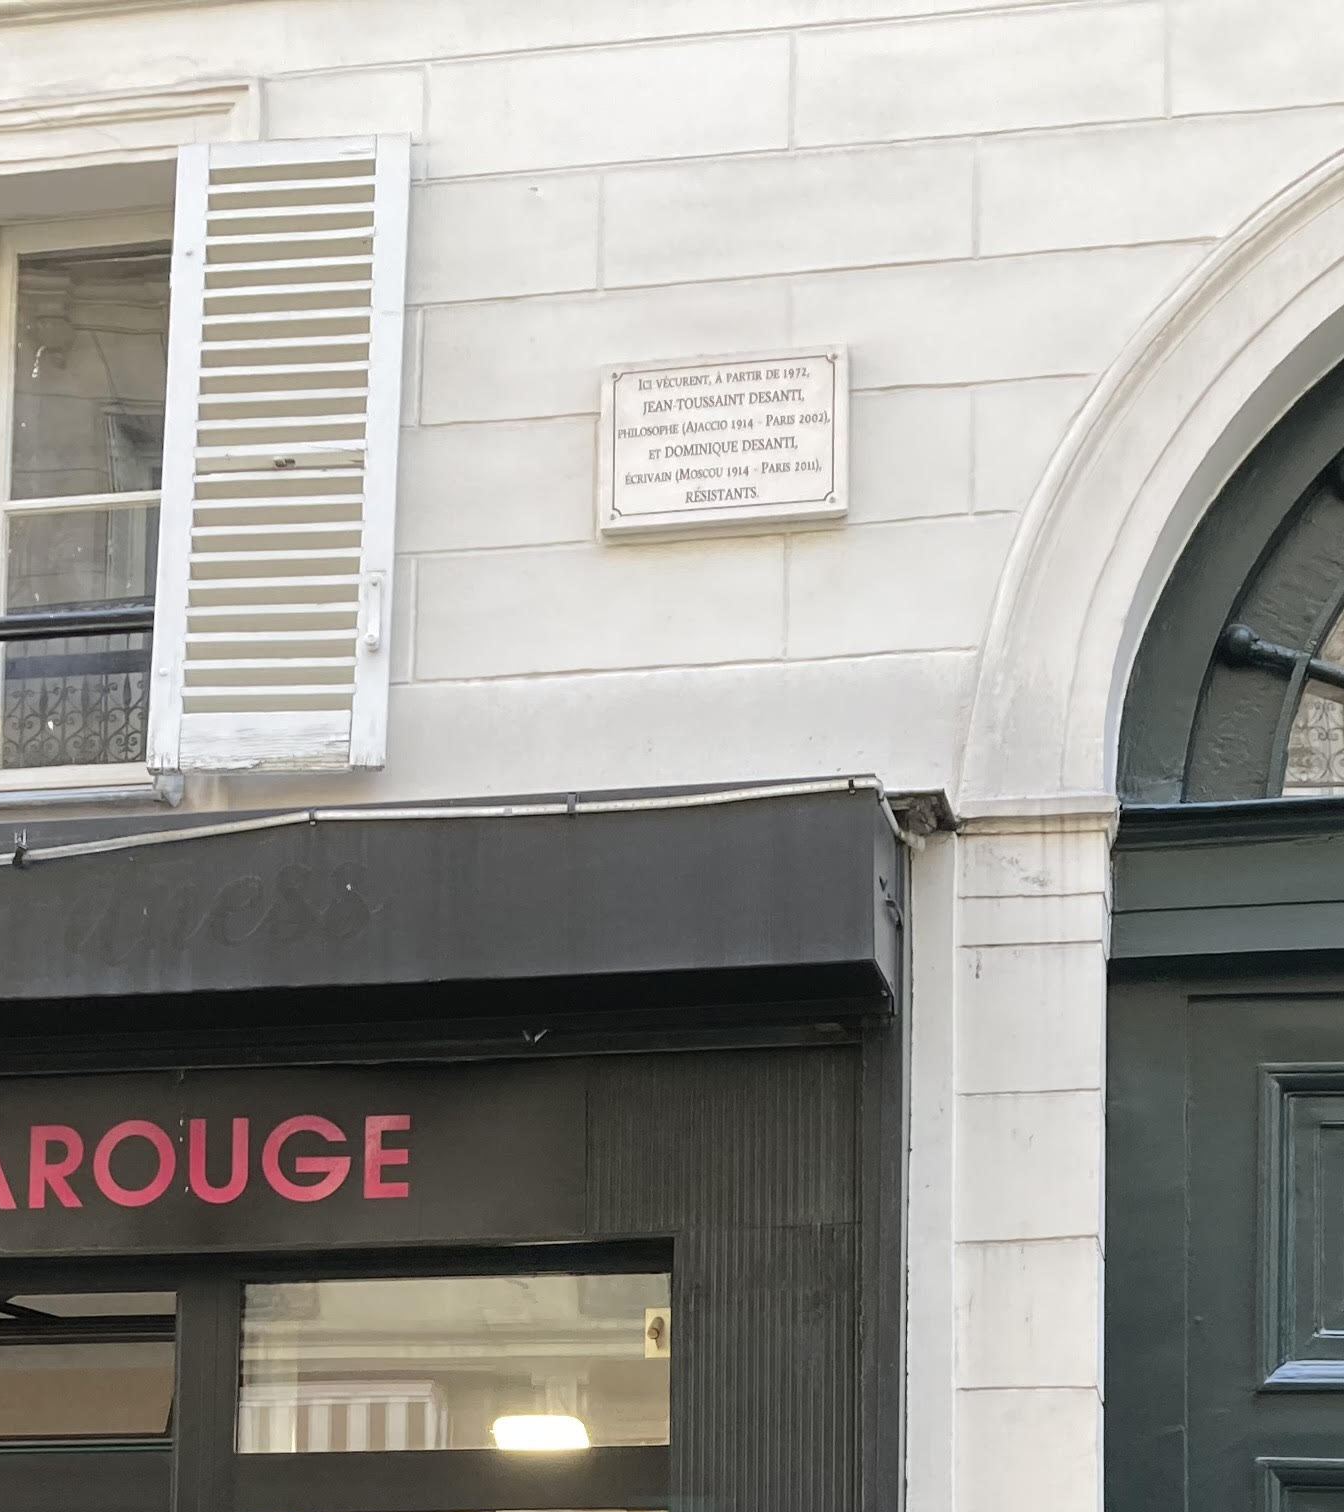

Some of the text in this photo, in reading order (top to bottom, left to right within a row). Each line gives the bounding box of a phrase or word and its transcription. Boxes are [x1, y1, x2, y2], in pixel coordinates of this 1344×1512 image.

[656, 375, 712, 389] VÉCURENT,
[726, 370, 762, 383] PARTIR
[766, 369, 780, 380] DE
[783, 367, 810, 379] 1972,
[749, 388, 805, 404] DESANTI,
[617, 424, 679, 439] PHILOSOPHE
[682, 420, 728, 436] (AJACCIO
[731, 418, 753, 431] 1914
[765, 414, 795, 427] PARIS
[799, 410, 830, 425] 2002),
[648, 436, 798, 460] ET DOMINIQUE DESANTI,
[625, 471, 672, 485] ÉCRIVAIN
[675, 467, 723, 483] (MOSCOU
[727, 466, 749, 477] 1914
[761, 461, 791, 474] PARIS
[794, 458, 822, 472] 2011),
[685, 486, 759, 503] RÉSISTANTS.
